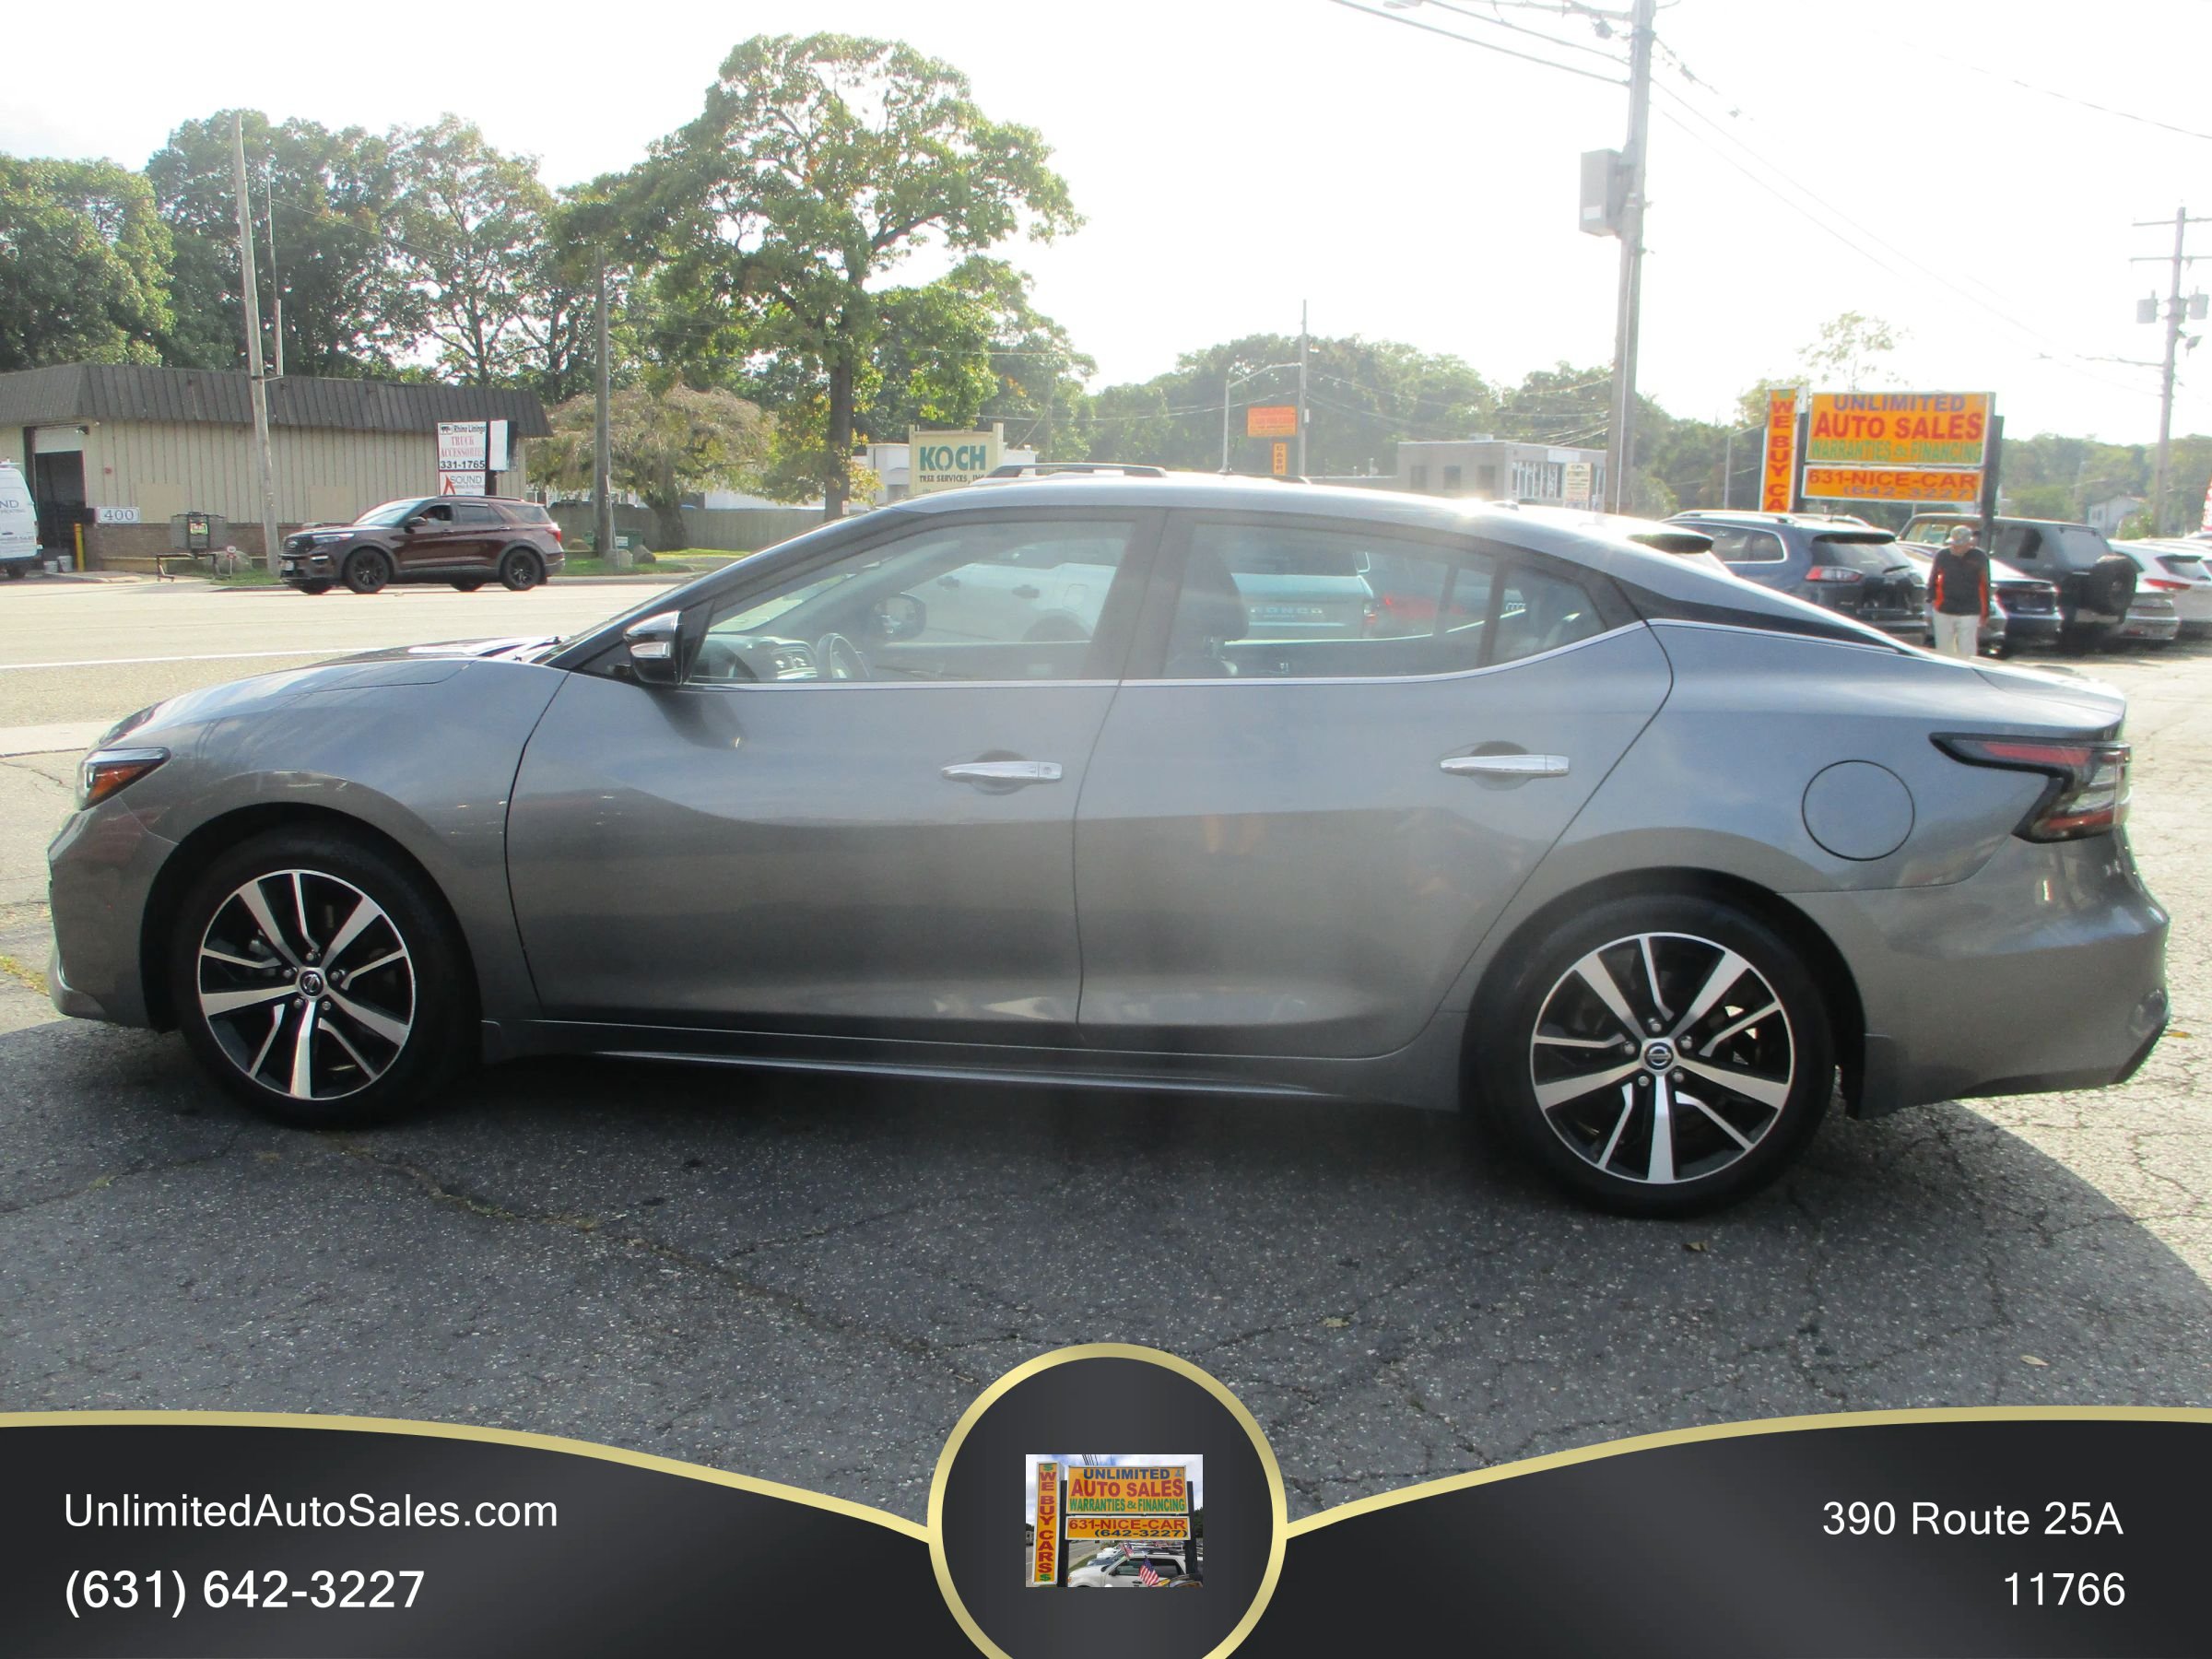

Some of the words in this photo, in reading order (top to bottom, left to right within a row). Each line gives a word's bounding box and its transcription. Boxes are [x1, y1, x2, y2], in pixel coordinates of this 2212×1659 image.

[1834, 394, 1965, 412] UNLIMITED
[1771, 401, 1794, 429] WE
[1814, 412, 1886, 438] AUTO
[1895, 413, 1982, 440] SALES
[452, 437, 475, 446] TRUCK
[441, 448, 485, 458] ACCESSORIES
[920, 446, 986, 471] KOCH
[1770, 435, 1790, 477] BUY
[1811, 440, 1891, 460] WARRANTIES
[1911, 441, 1983, 462] FINANCING
[451, 476, 482, 484] SOUND
[1808, 470, 1976, 488] 631-NICE-CAR
[1767, 484, 1787, 512] CA
[1843, 487, 1978, 500] (642-3227)
[103, 509, 134, 521] 400
